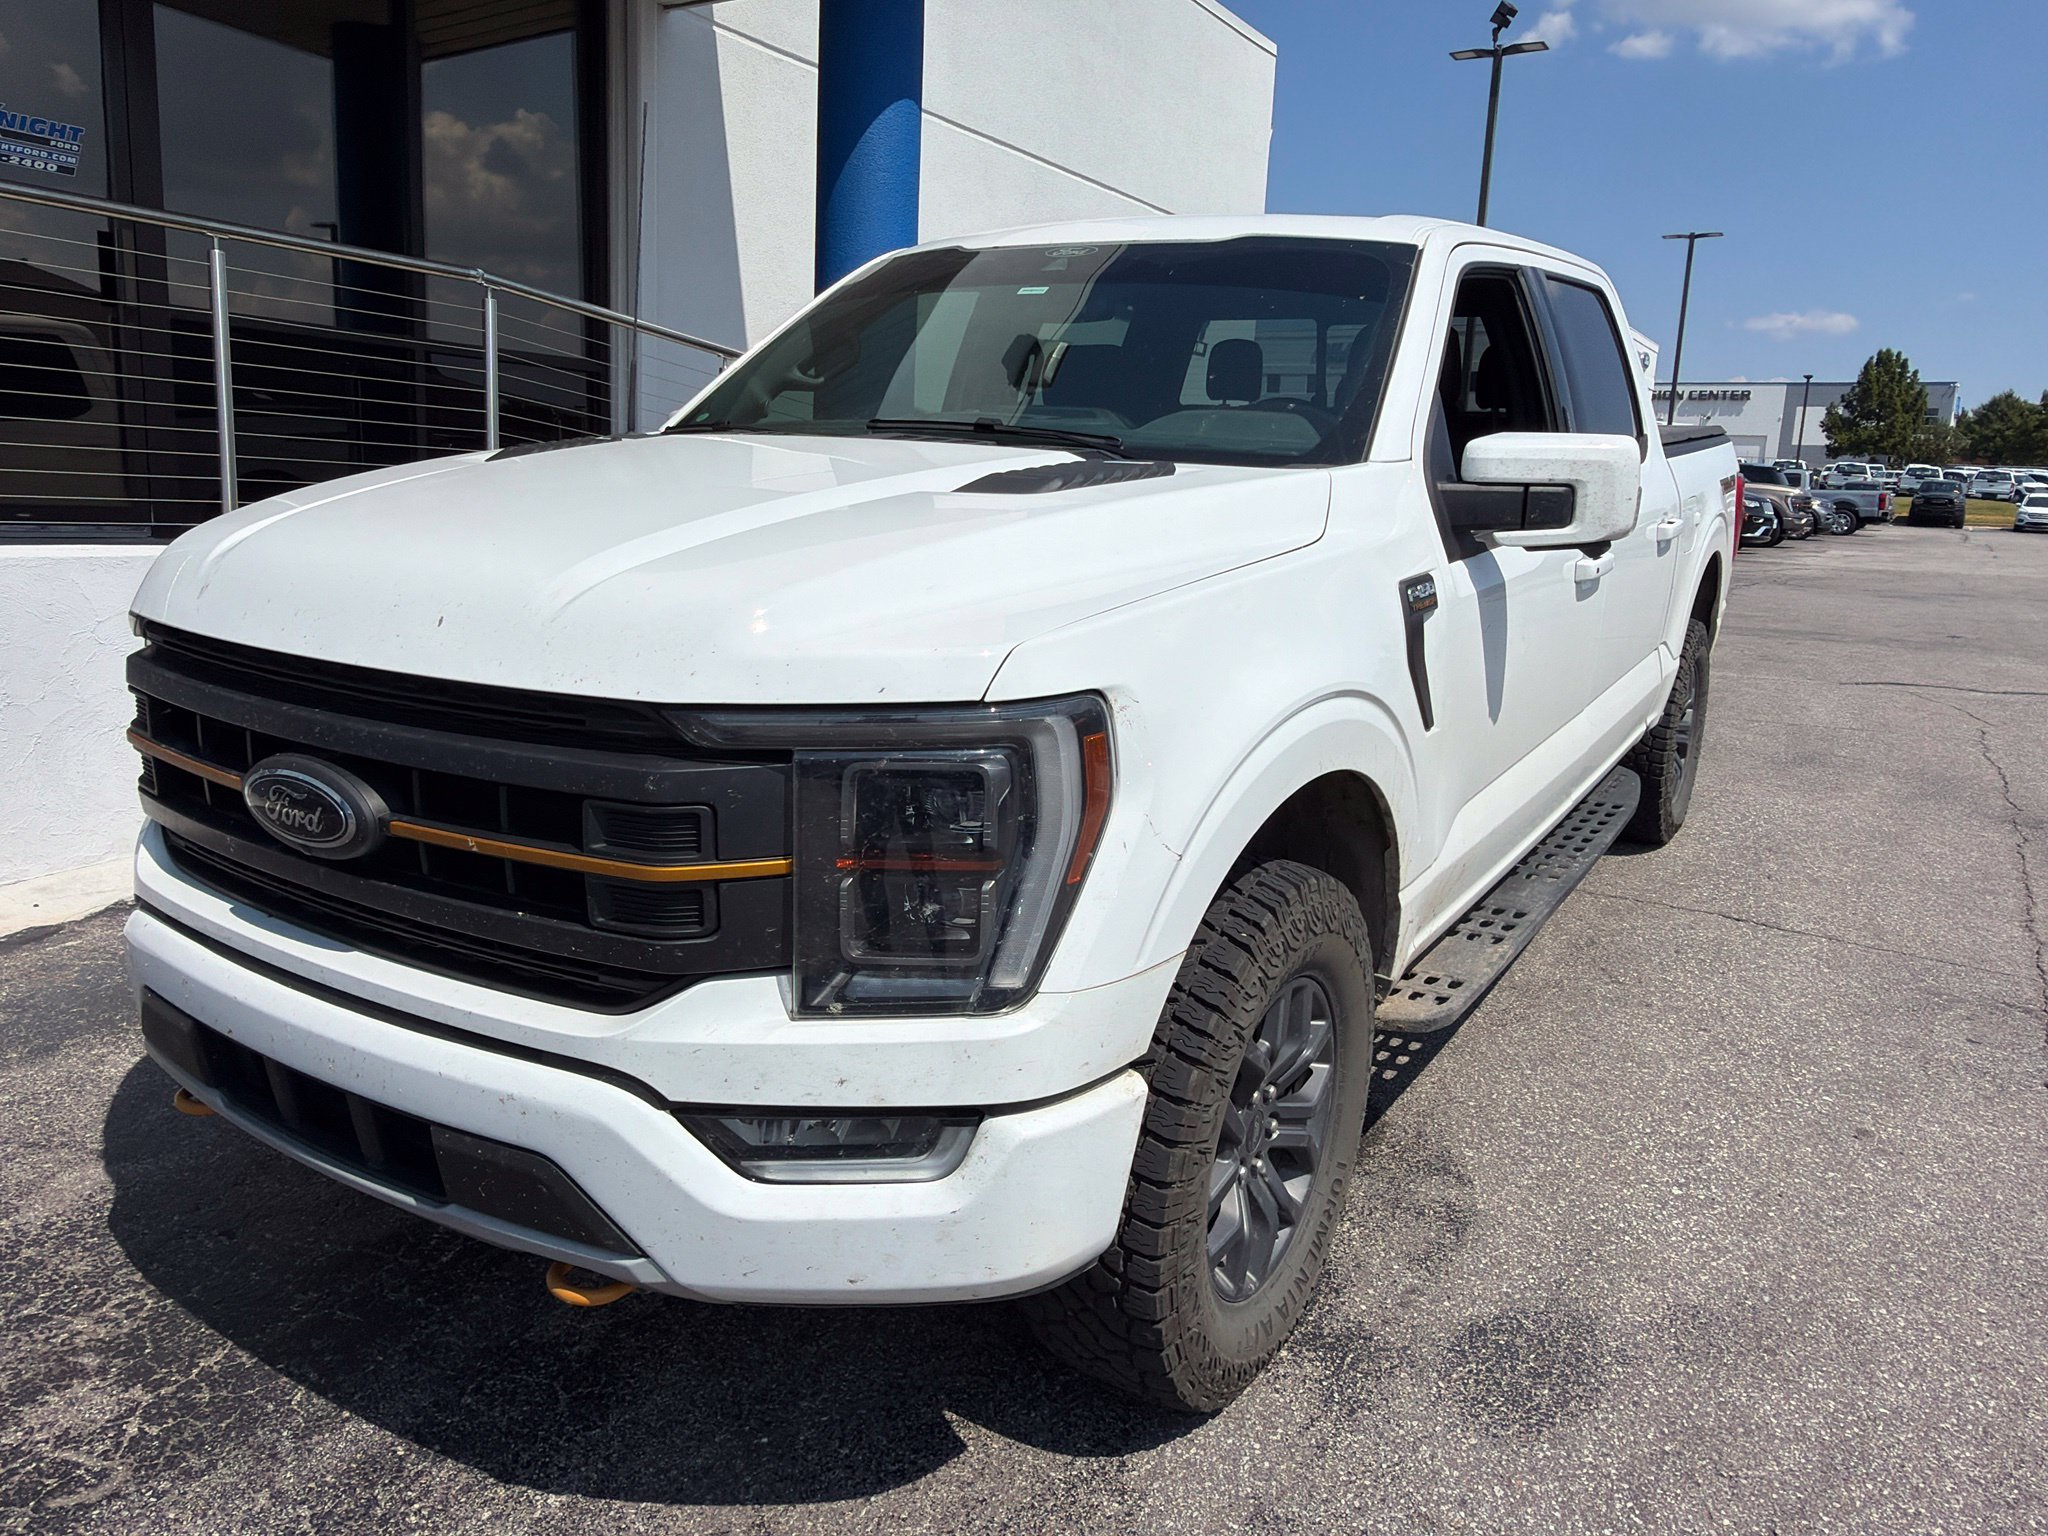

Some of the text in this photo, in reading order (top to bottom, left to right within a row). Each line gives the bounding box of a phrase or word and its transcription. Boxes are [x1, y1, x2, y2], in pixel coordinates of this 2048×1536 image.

[0, 108, 85, 143] NIGHT
[49, 140, 79, 152] FORD
[1688, 390, 1752, 401] CENTER
[264, 784, 325, 834] Ford
